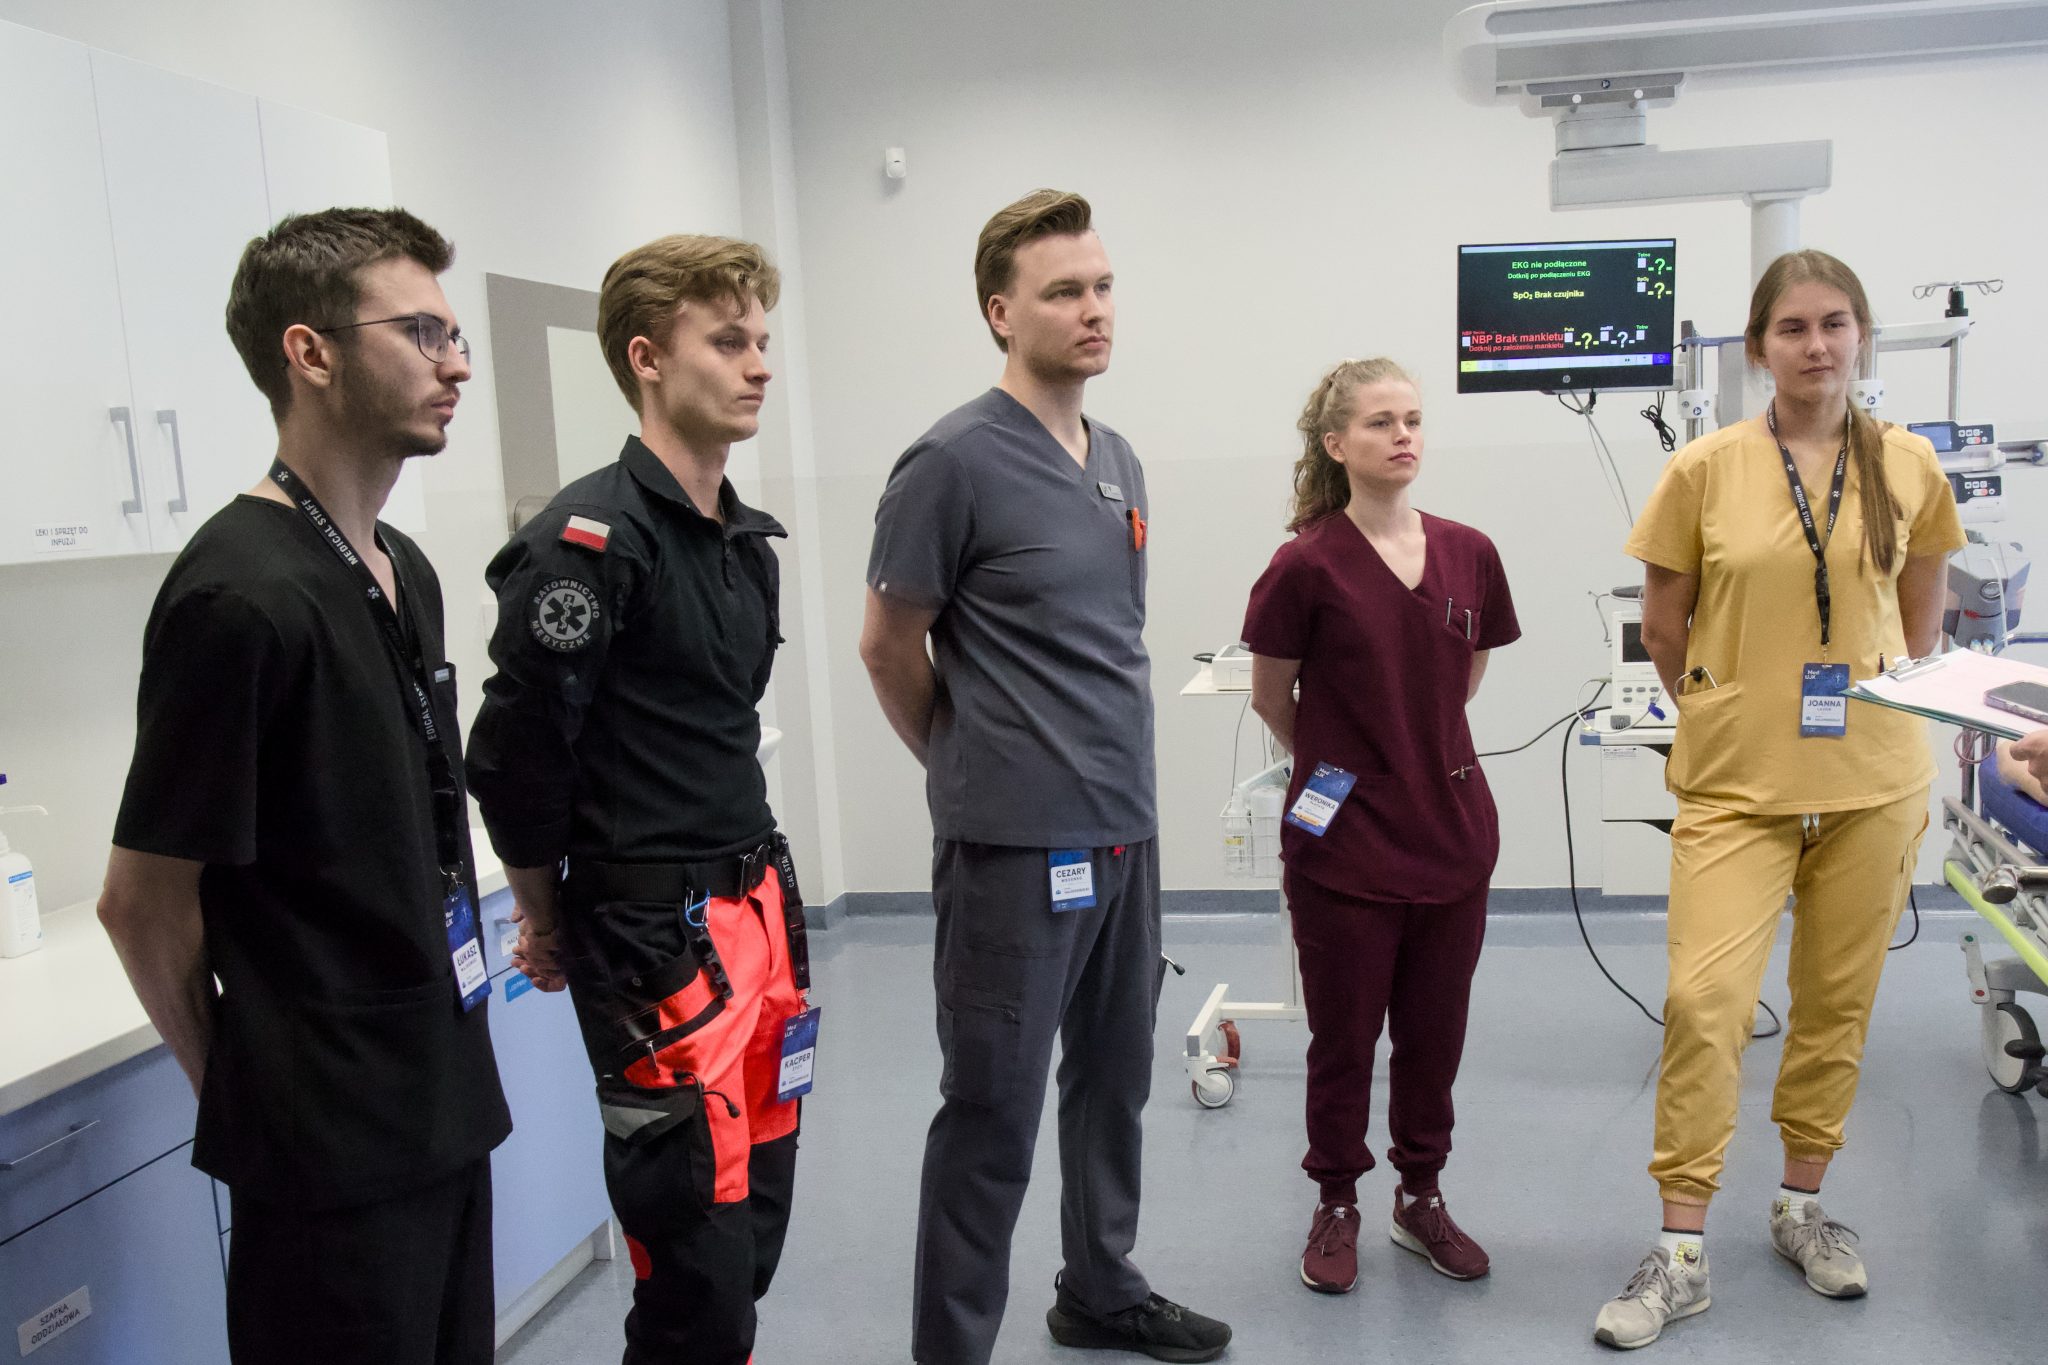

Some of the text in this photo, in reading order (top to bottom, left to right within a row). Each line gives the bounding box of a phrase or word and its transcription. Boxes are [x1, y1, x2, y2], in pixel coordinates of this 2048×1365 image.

[1554, 290, 1584, 299] czujnika
[1472, 332, 1564, 344] NBP Brak mankietu
[1794, 485, 1812, 529] MEDICAL STAFF
[79, 526, 88, 534] DO
[300, 498, 358, 565] MEDICAL STAFF
[534, 580, 600, 619] RATOWNICTWO
[531, 620, 592, 650] MEDYCZNE
[1304, 792, 1336, 810] WERONIKA
[1056, 868, 1086, 878] CEZARY
[456, 944, 478, 966] ŁUKASZ
[784, 1052, 811, 1070] KACPER
[31, 1308, 80, 1344] ODDZIAŁOWA
[40, 1304, 69, 1326] SZAFKA
